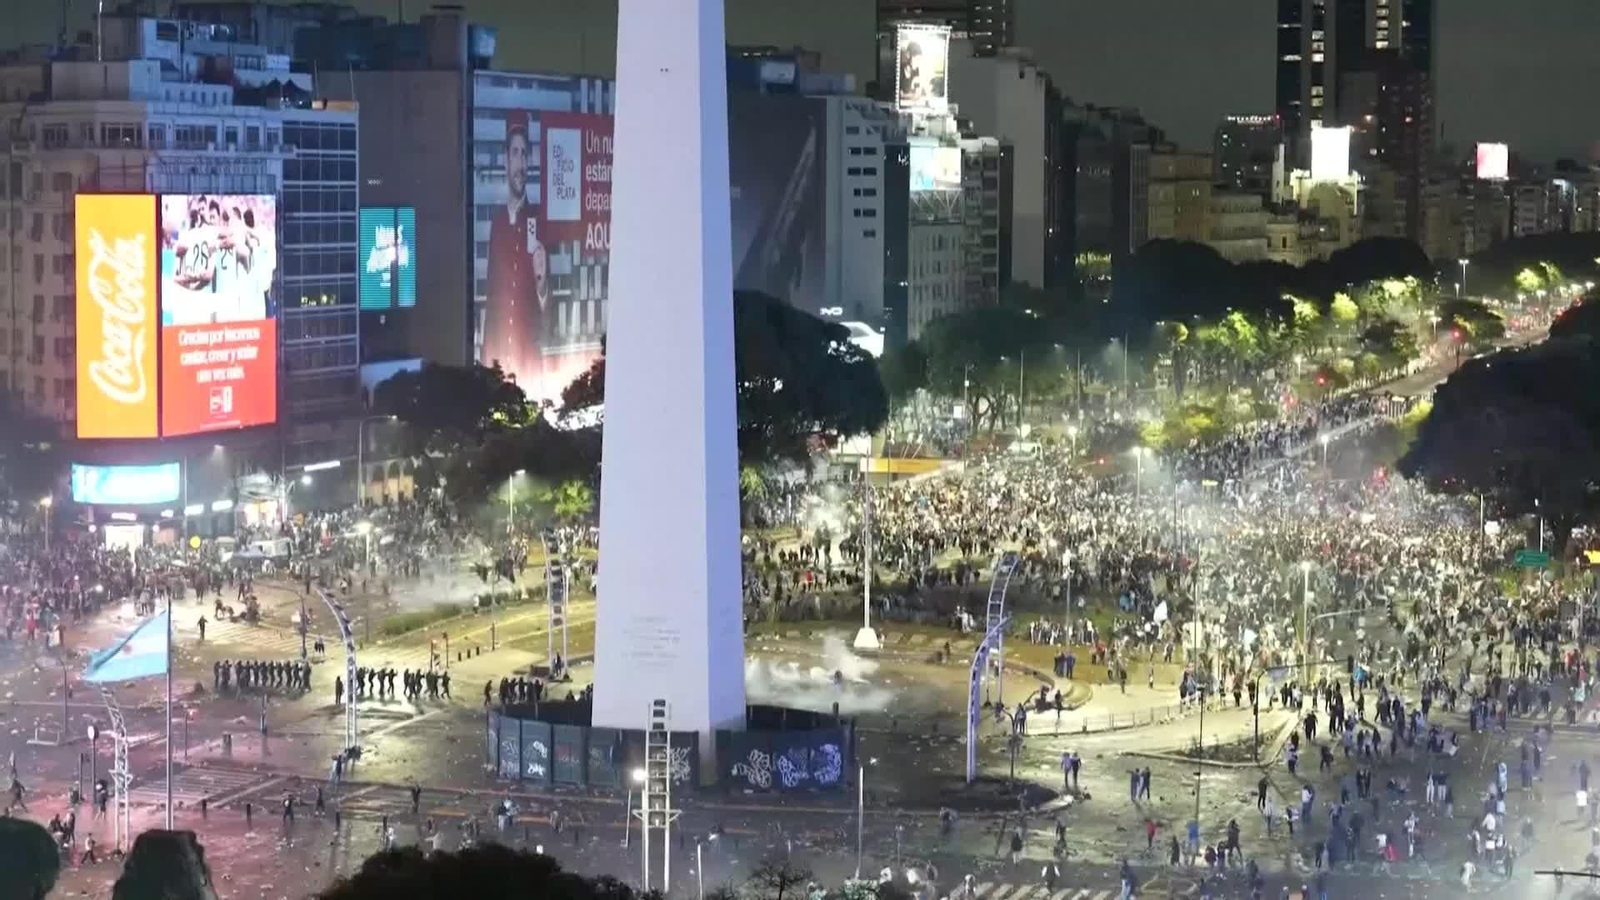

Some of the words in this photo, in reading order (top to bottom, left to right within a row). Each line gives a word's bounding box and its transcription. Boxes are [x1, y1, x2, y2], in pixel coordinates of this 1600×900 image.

[585, 130, 600, 154] Un
[557, 187, 576, 200] PLATA
[87, 227, 147, 404] Coca-Cola
